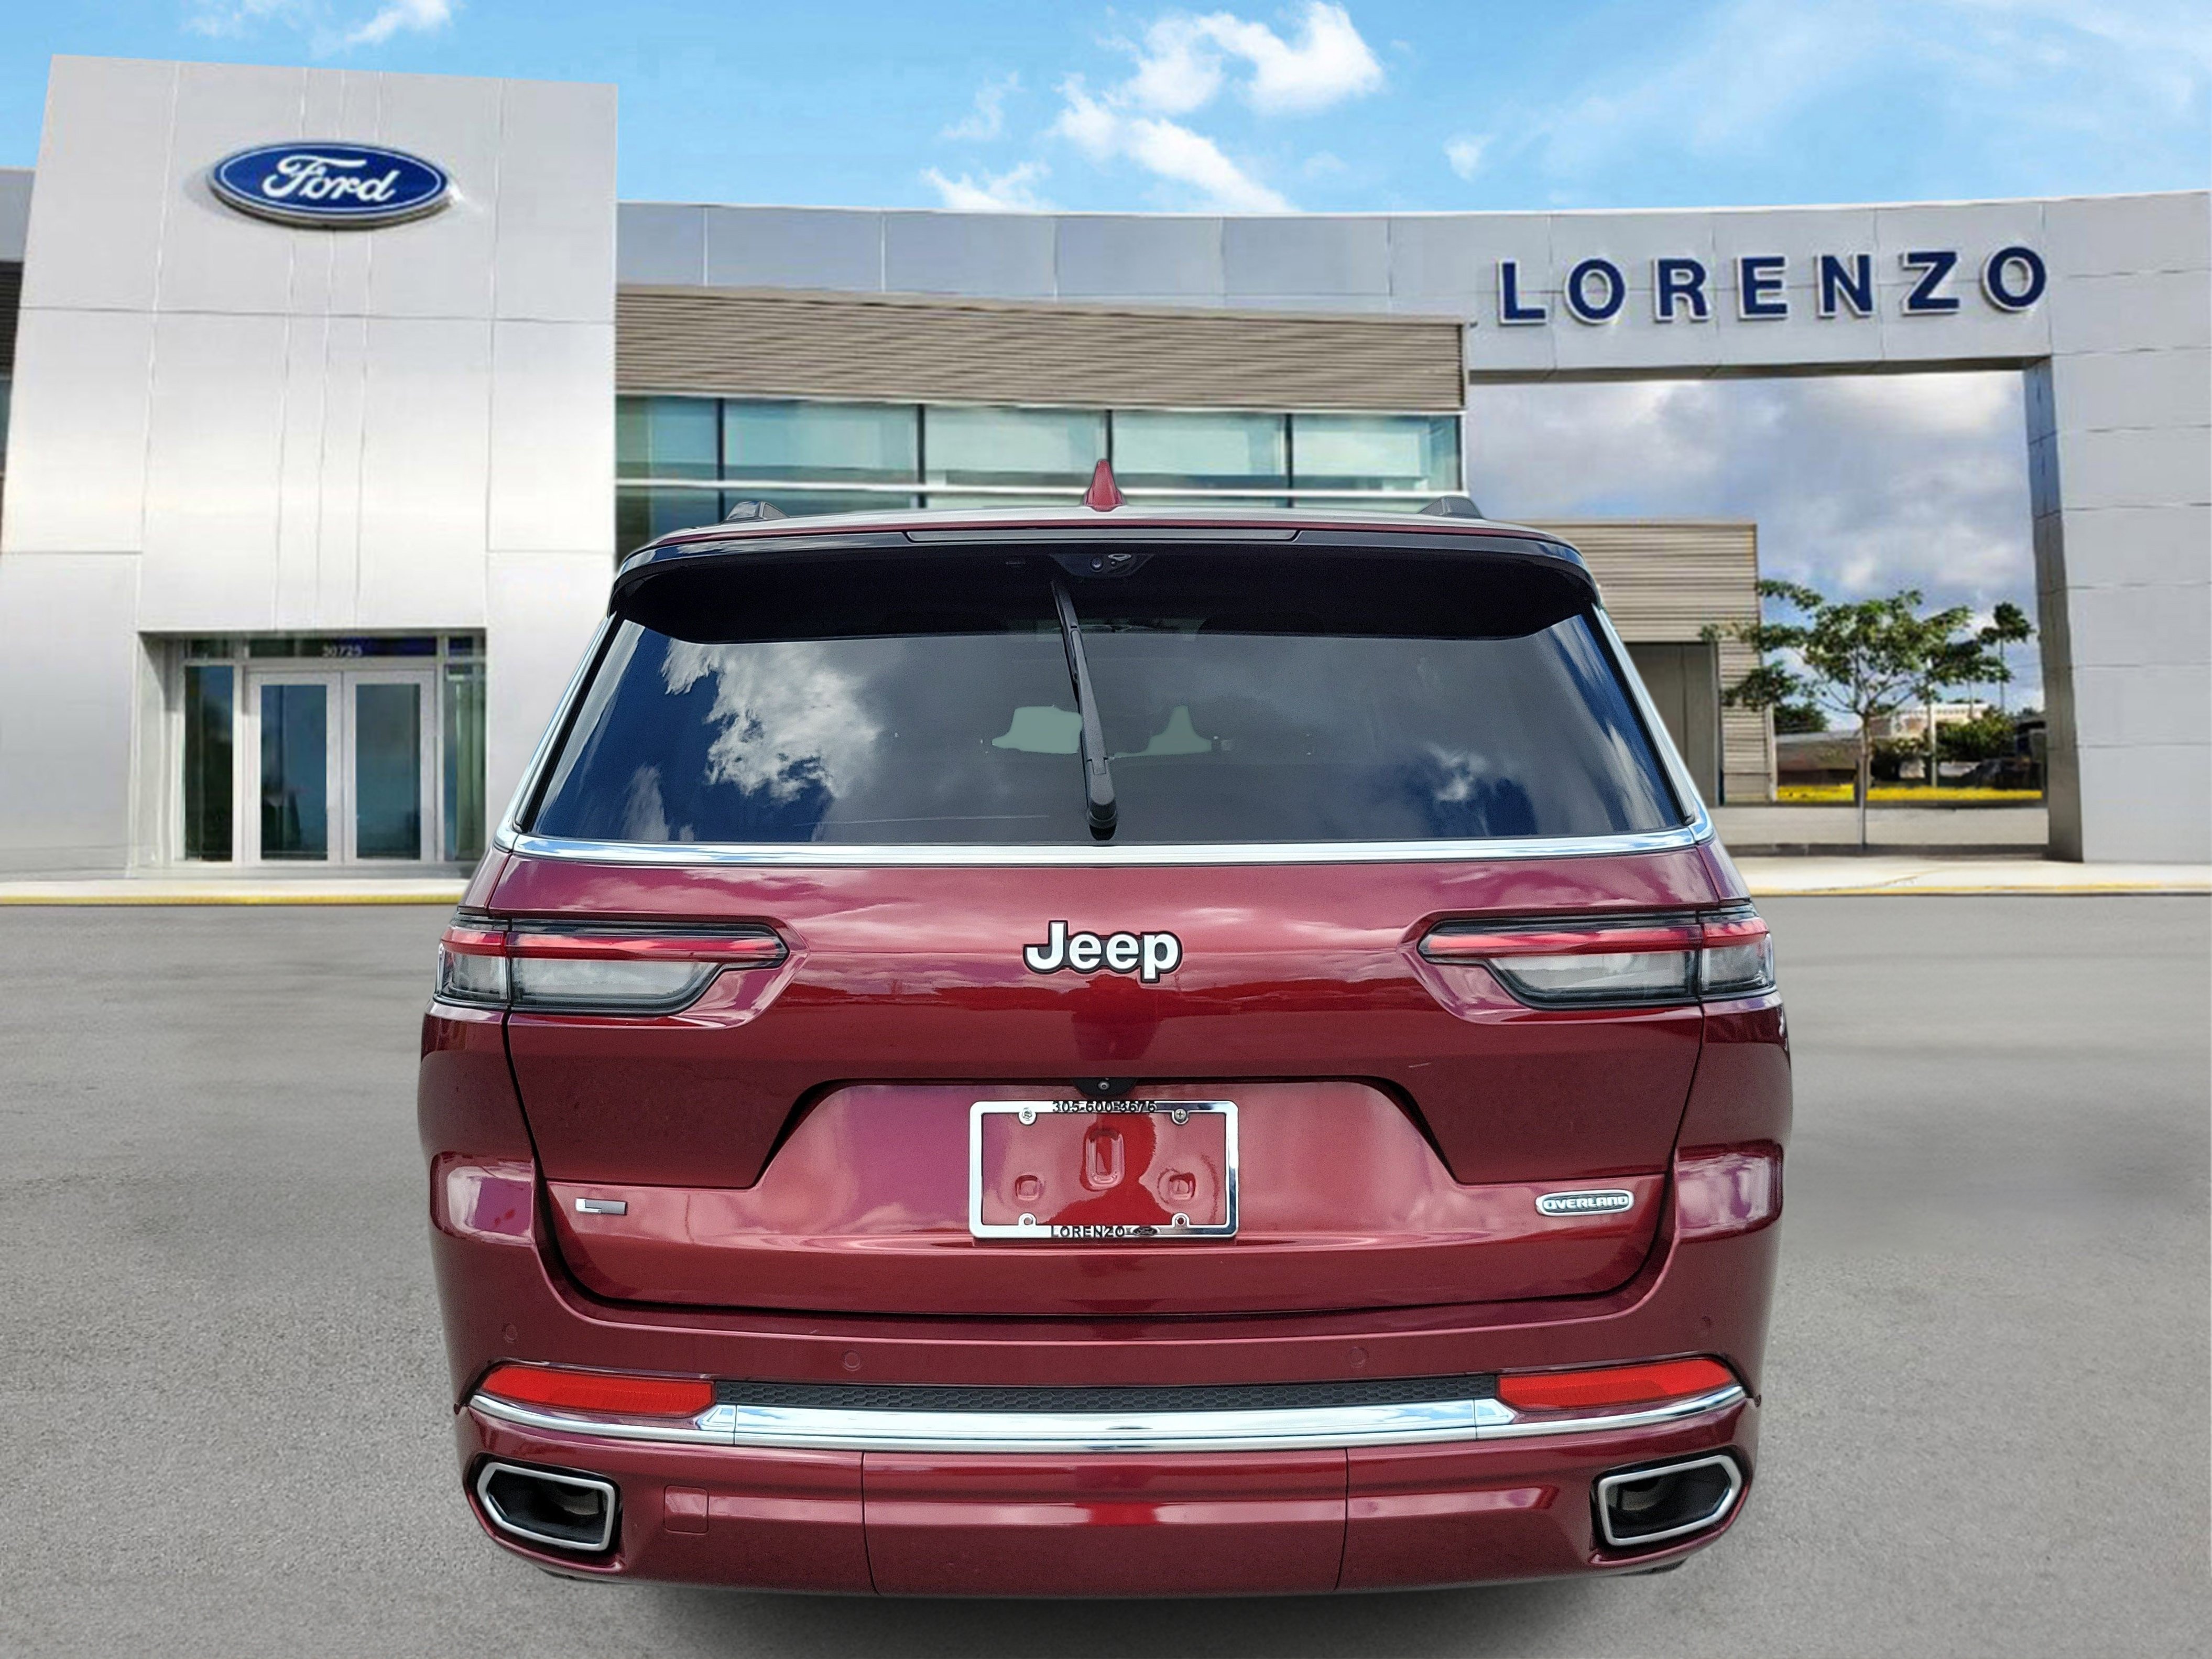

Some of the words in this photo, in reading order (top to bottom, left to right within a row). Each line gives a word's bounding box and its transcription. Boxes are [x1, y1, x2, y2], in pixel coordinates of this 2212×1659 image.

[261, 154, 400, 201] Ford
[1498, 246, 2047, 325] LORENZO
[1026, 921, 1180, 980] Jeep
[1543, 1196, 1629, 1210] OVERLAND
[1051, 1225, 1126, 1238] LORENZO
